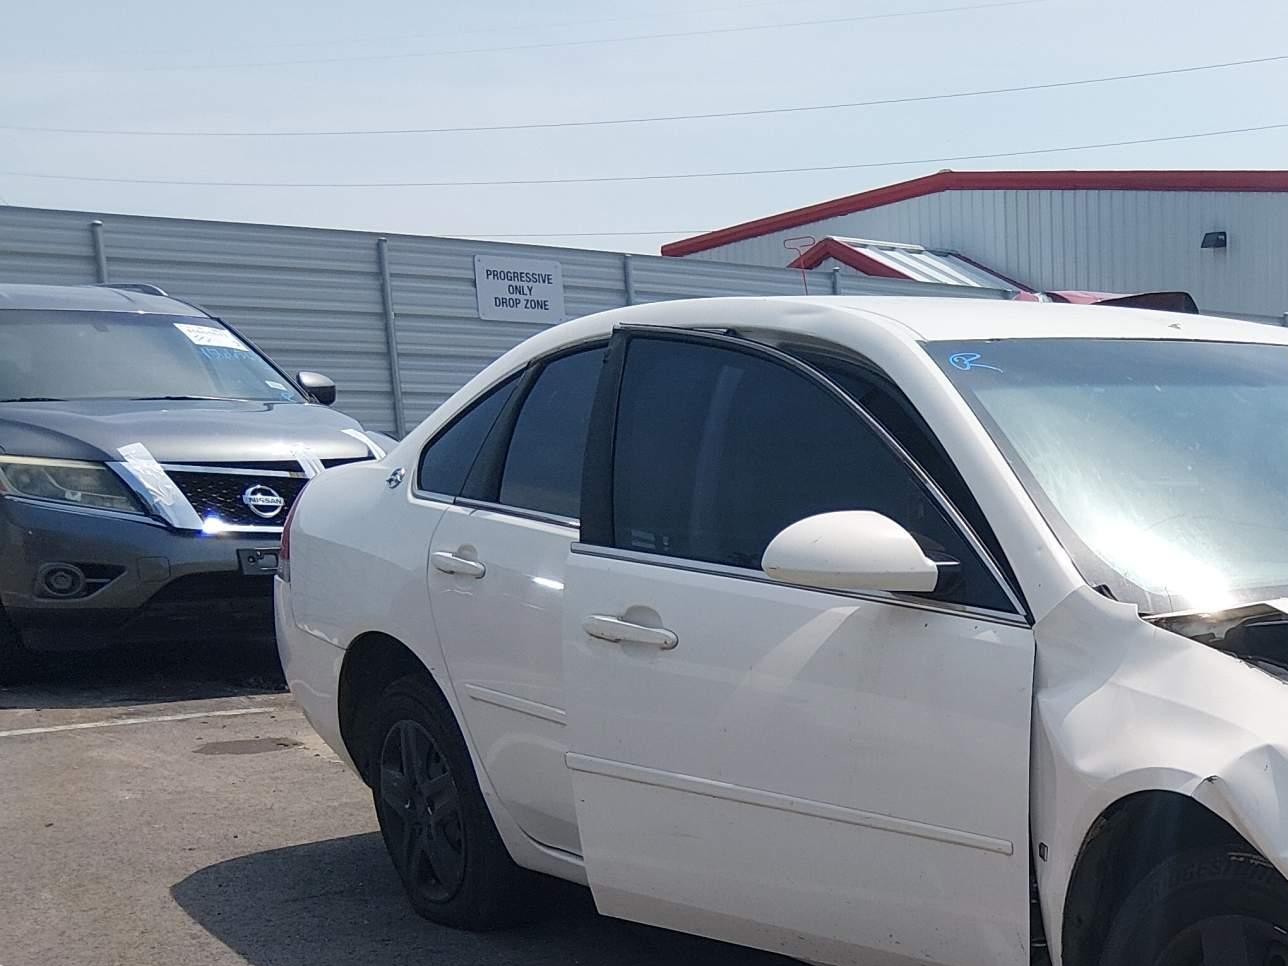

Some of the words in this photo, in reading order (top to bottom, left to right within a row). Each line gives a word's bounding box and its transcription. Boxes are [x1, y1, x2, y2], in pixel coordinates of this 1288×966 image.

[486, 269, 553, 285] PROGRESSIVE
[507, 284, 533, 296] ONLY
[494, 296, 521, 309] DROP
[523, 298, 550, 311] ZONE
[248, 496, 282, 504] NISSAN
